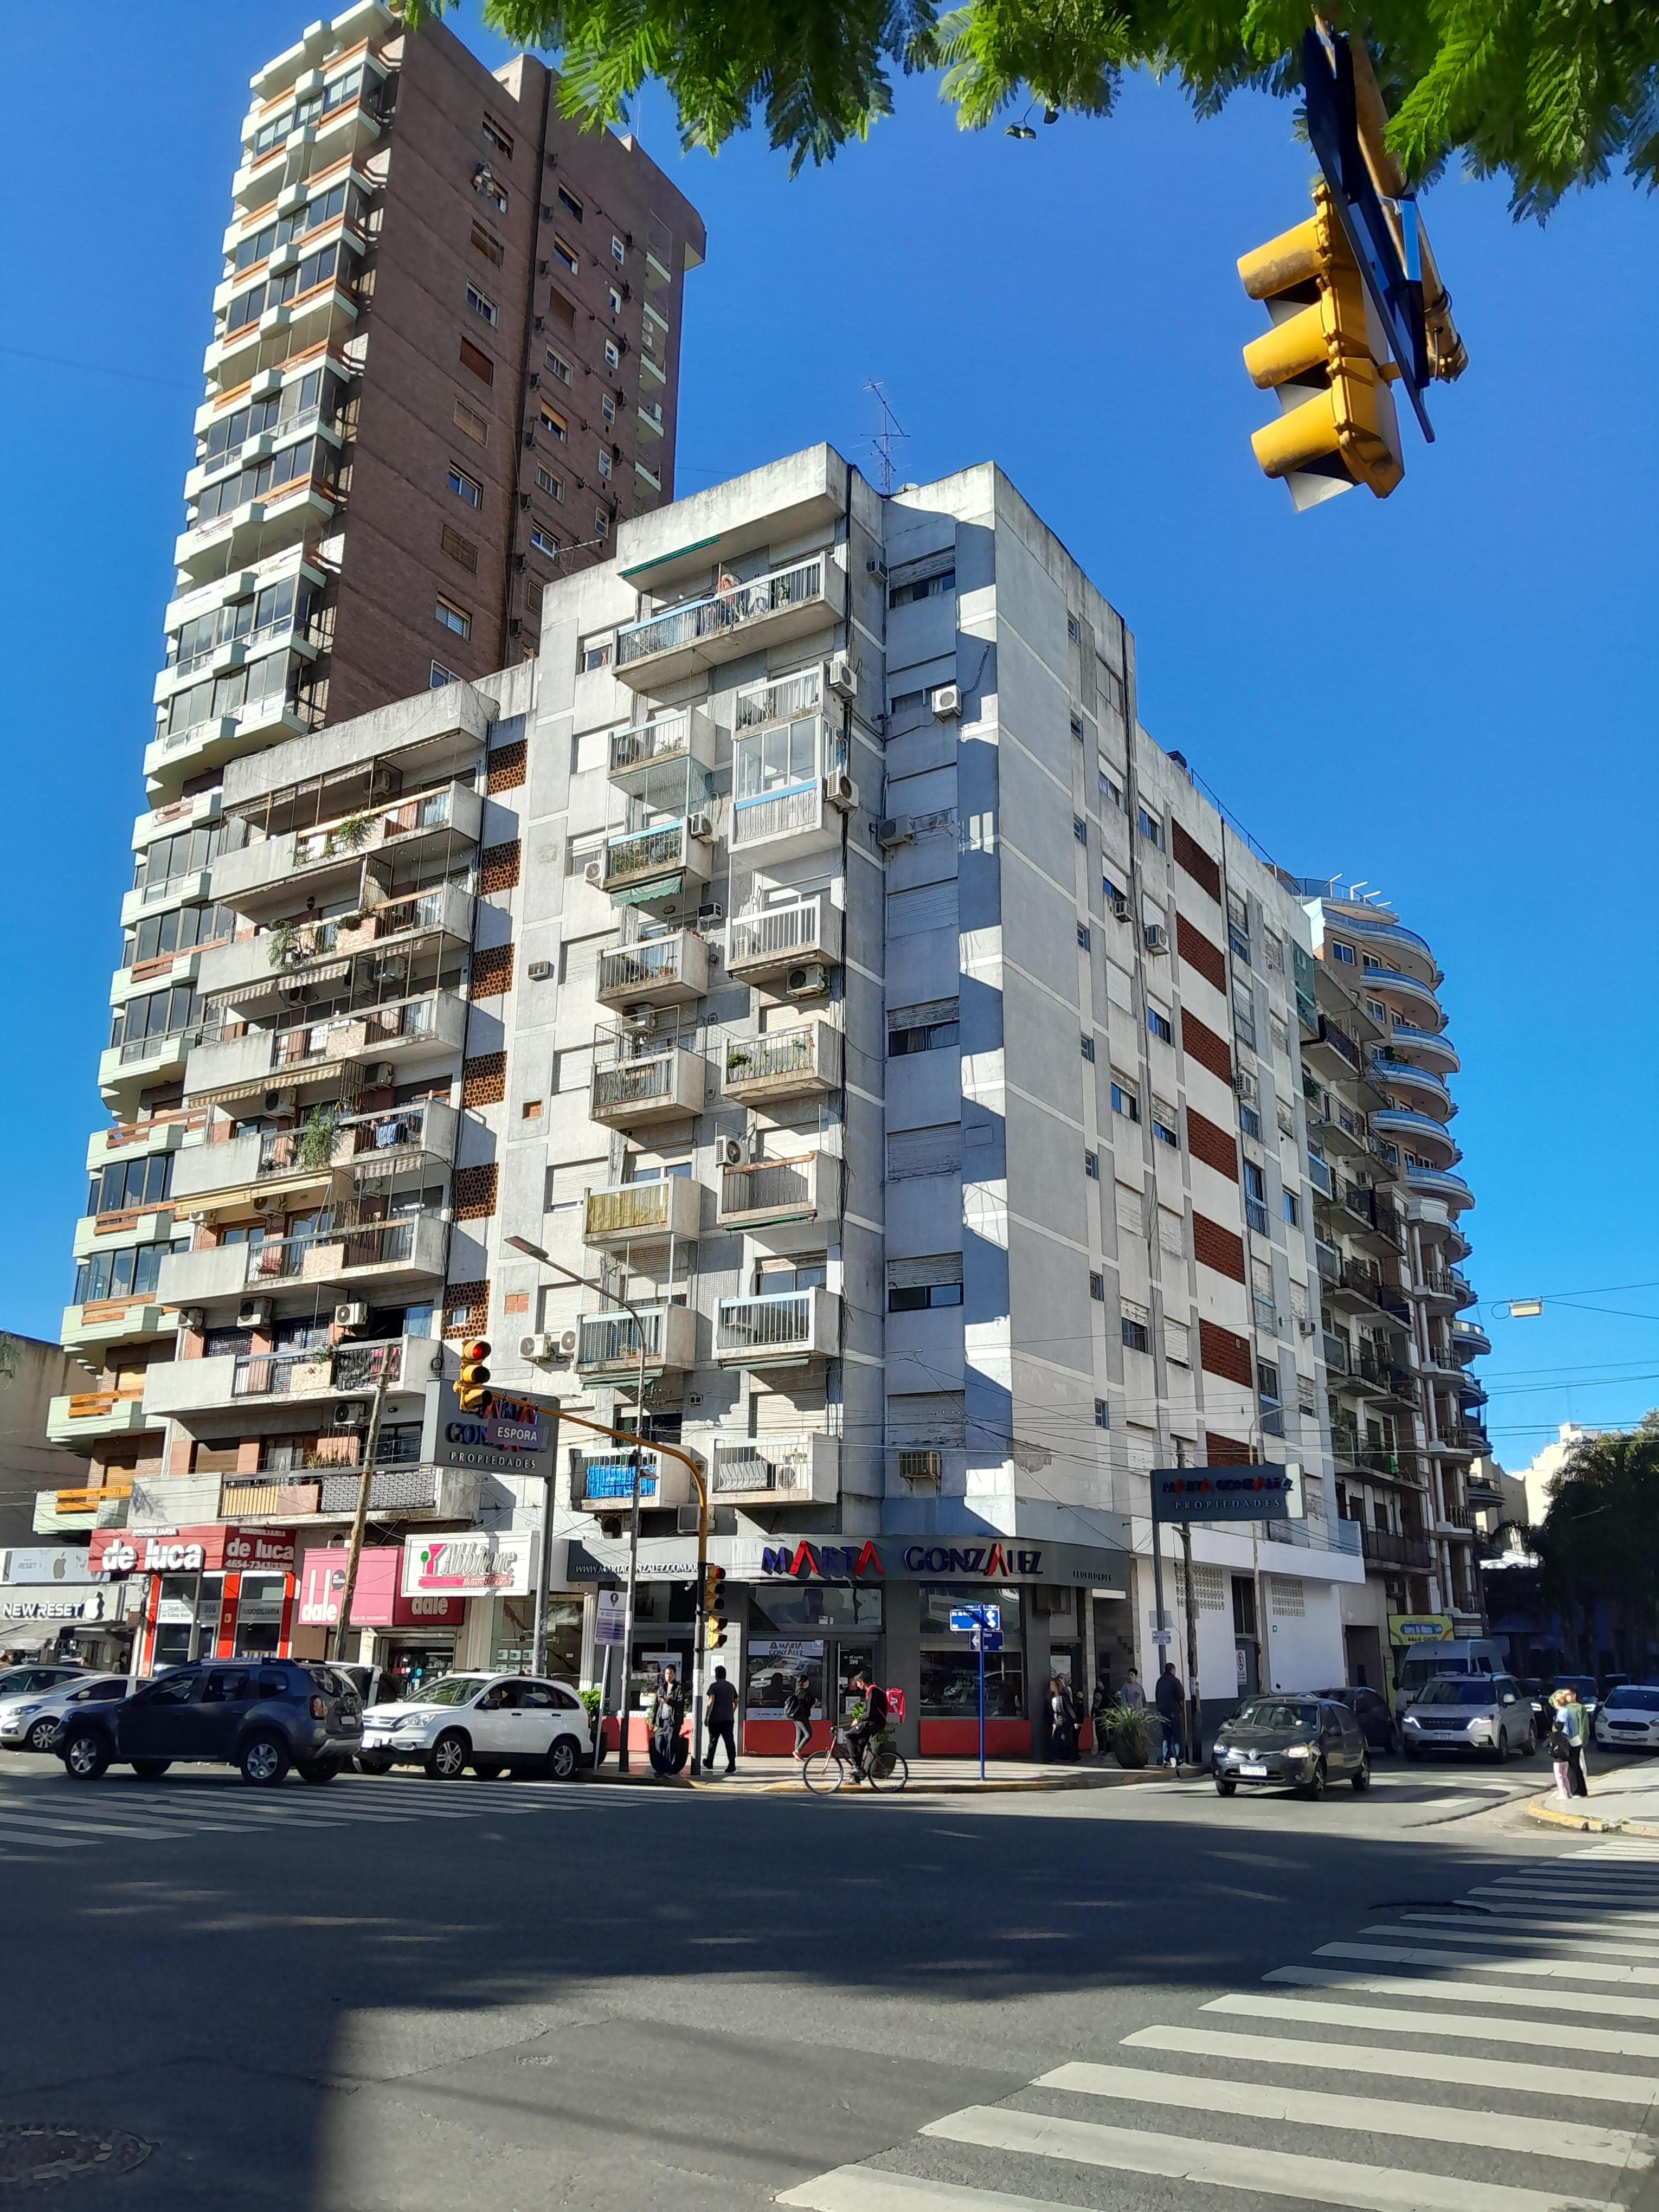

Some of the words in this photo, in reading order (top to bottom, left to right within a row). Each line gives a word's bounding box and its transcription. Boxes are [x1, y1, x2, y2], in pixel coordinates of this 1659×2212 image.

[497, 1426, 538, 1441] ESPORA
[449, 1451, 537, 1469] PROPIEDADES
[1162, 1478, 1213, 1494] MARTA
[1175, 1499, 1281, 1510] PROPIEDADES
[239, 1527, 286, 1537] INMOBILIARIA
[101, 1539, 137, 1570] de
[144, 1538, 203, 1570] luca
[226, 1538, 251, 1557] de
[254, 1539, 294, 1560] luca
[441, 1542, 517, 1575] Abbitare
[761, 1540, 885, 1577] MARTA
[904, 1543, 1044, 1577] GONZALEZ
[575, 1563, 699, 1574] WWW.MARTAGNZALEZ.COM.AR
[301, 1568, 338, 1622] dale
[2, 1603, 36, 1617] NEW
[37, 1603, 81, 1617] RESET
